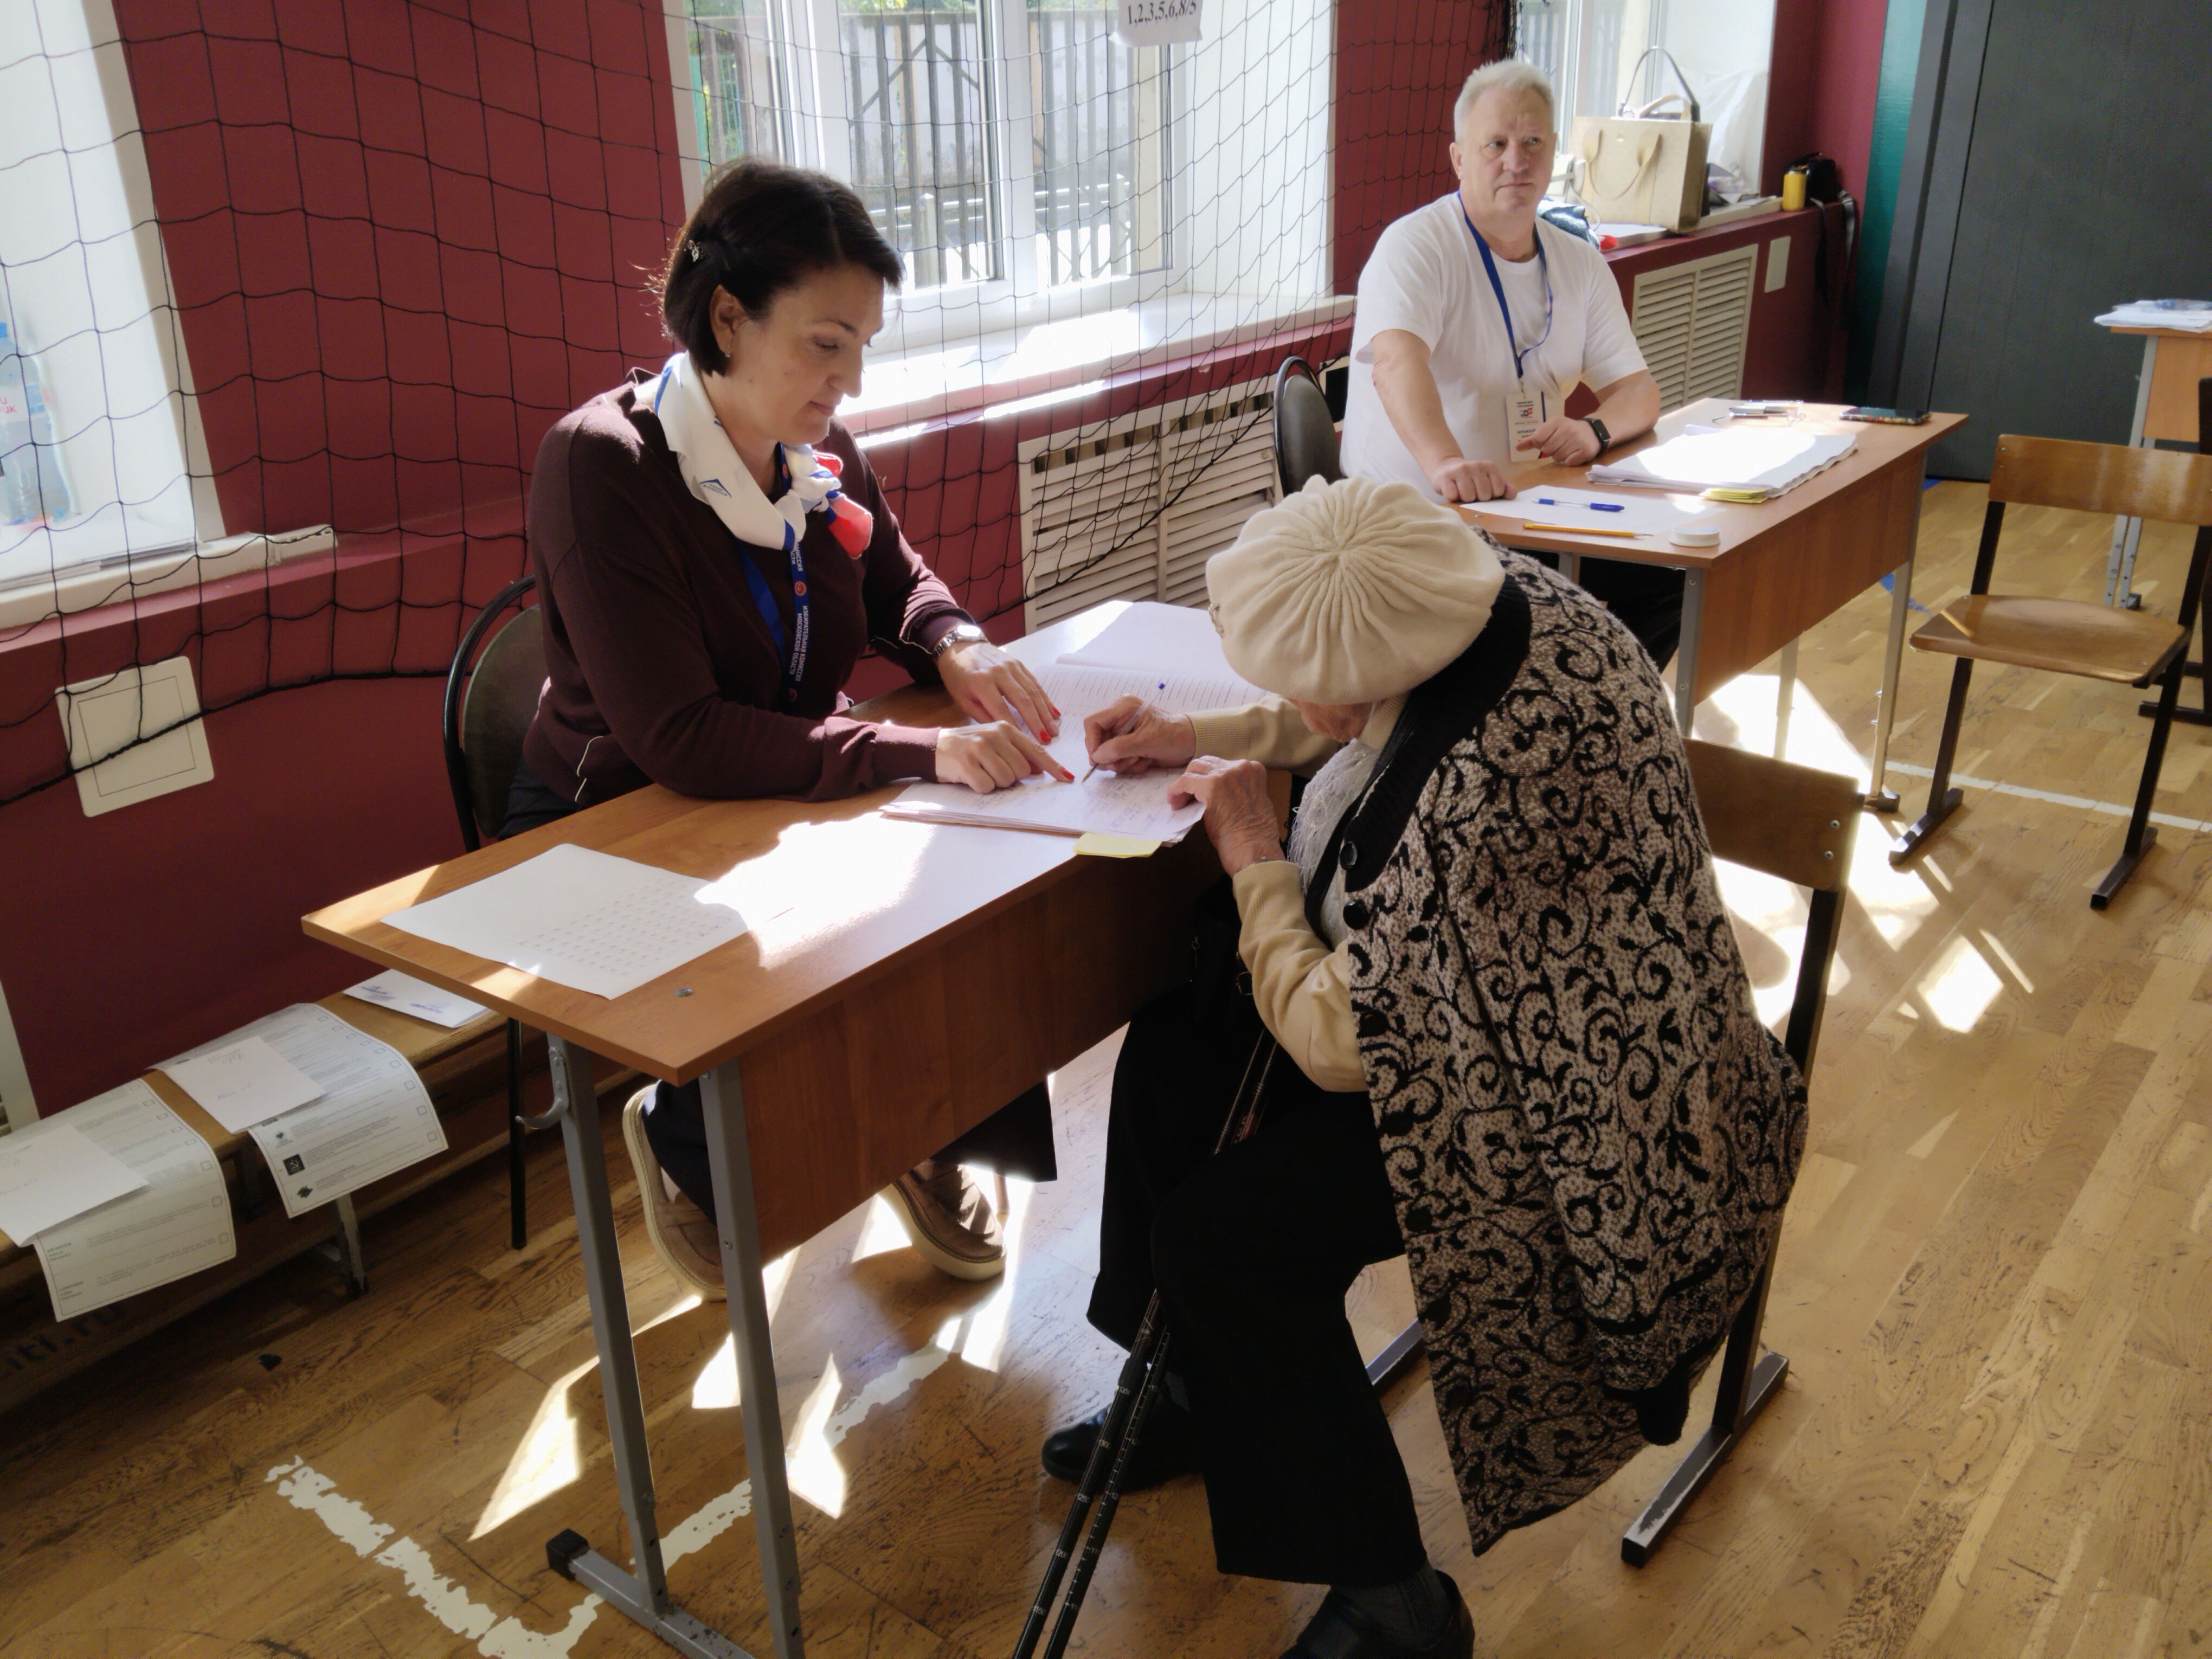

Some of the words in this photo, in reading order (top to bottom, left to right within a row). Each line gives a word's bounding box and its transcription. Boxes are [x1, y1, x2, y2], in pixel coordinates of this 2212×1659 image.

[794, 613, 802, 651] МОСКОВСКОЙ
[800, 606, 809, 652] ИЗБИРАТЕЛЬНАЯ
[789, 652, 799, 675] ОБЛАСТИ
[795, 653, 806, 682] КОМИССИЯ
